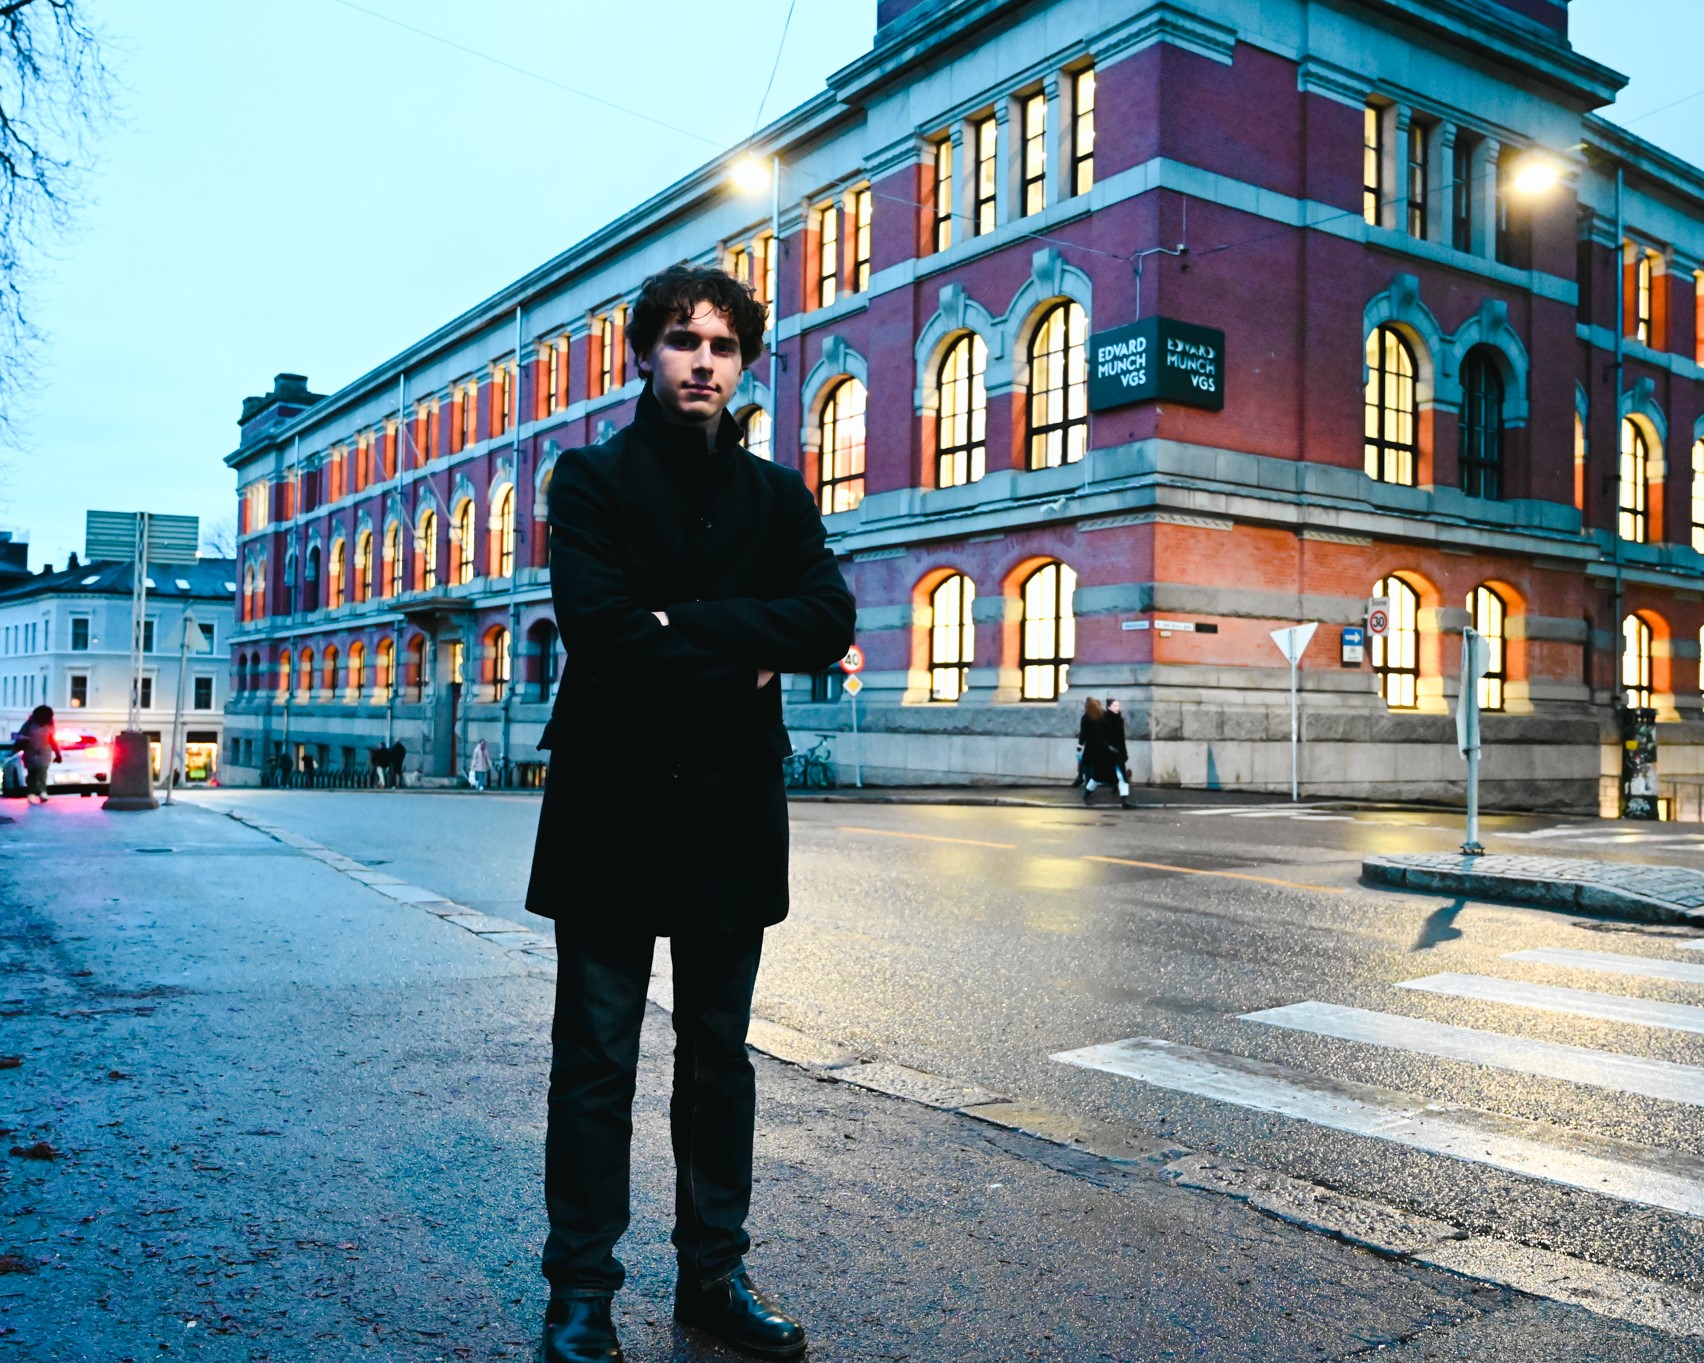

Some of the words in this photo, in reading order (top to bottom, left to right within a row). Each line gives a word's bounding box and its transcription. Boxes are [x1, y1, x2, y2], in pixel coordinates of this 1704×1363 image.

[1098, 337, 1146, 362] EDVARD
[1098, 353, 1146, 378] MUNCH
[1167, 352, 1215, 375] MUNCH
[1121, 370, 1146, 387] VGS
[1191, 374, 1216, 392] VGS
[1373, 616, 1385, 628] 30
[845, 653, 860, 666] 40
